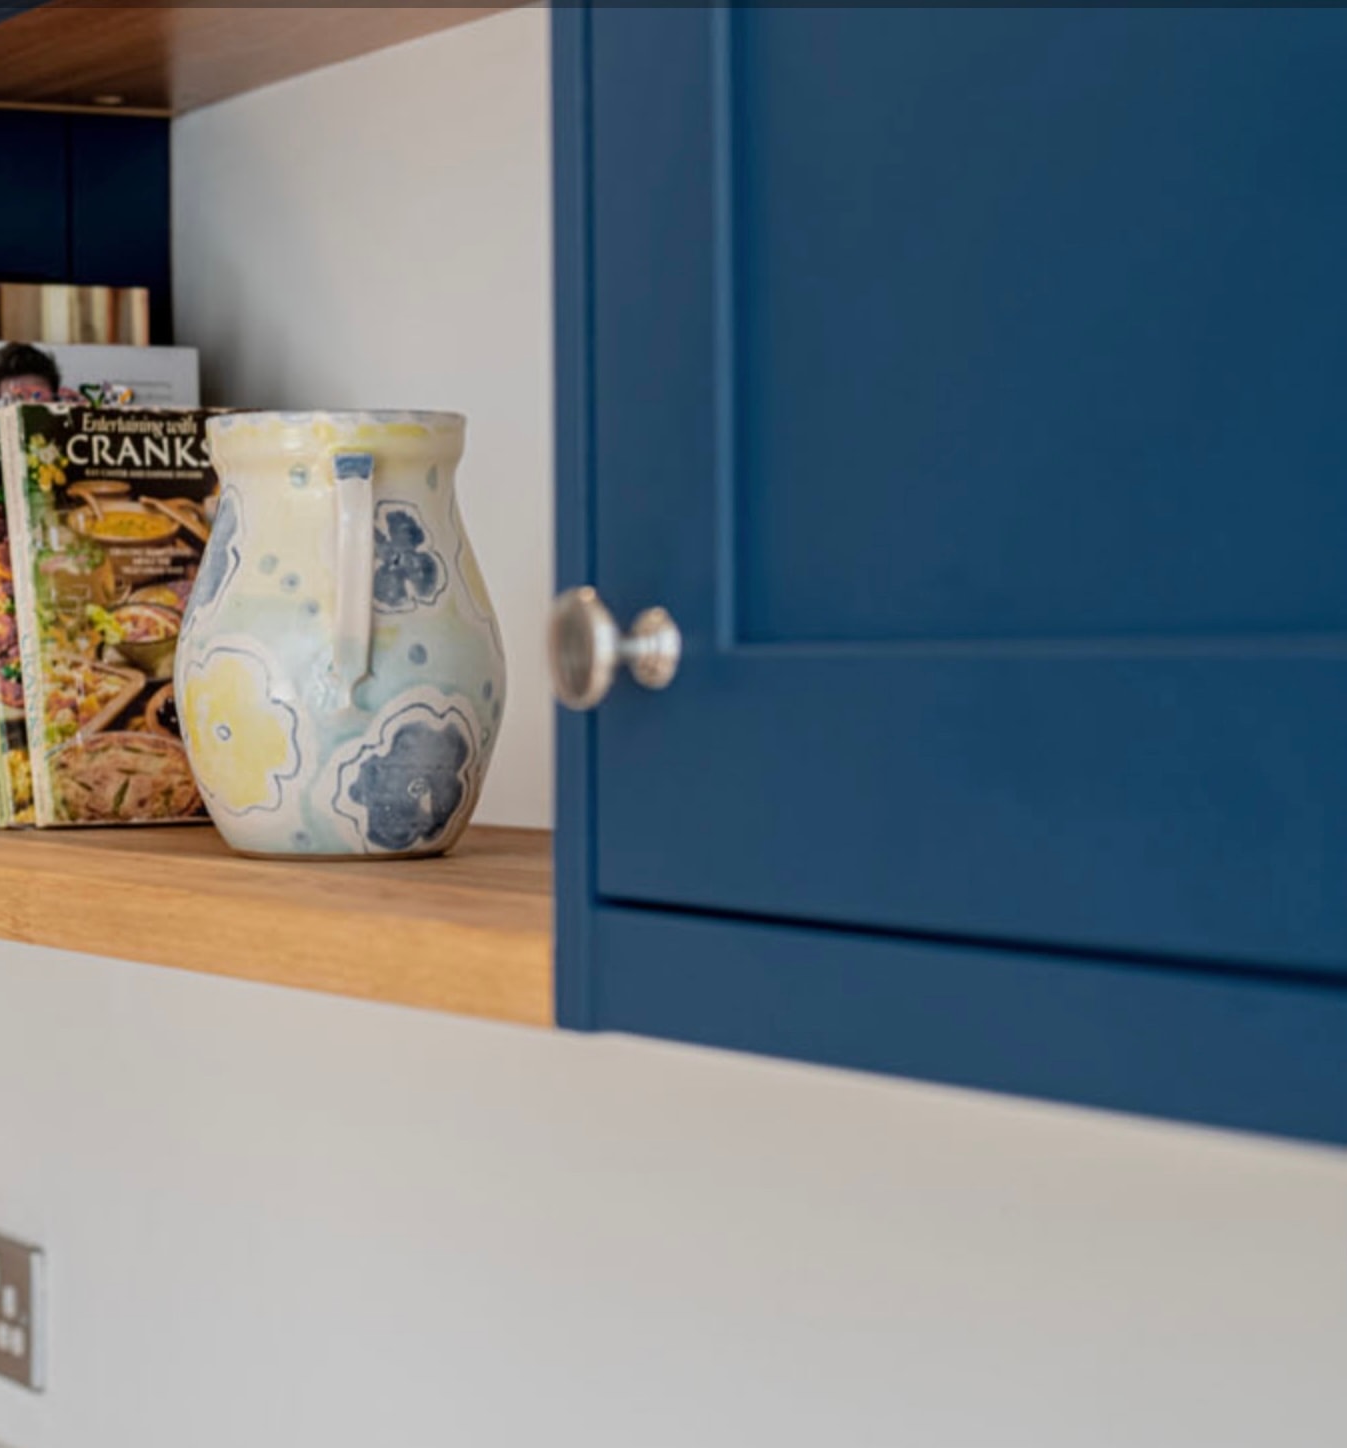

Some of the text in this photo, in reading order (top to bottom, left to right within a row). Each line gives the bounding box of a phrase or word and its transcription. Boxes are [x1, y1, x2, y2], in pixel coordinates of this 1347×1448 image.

[82, 412, 198, 438] Entertaining with
[66, 434, 212, 468] CRANKS
